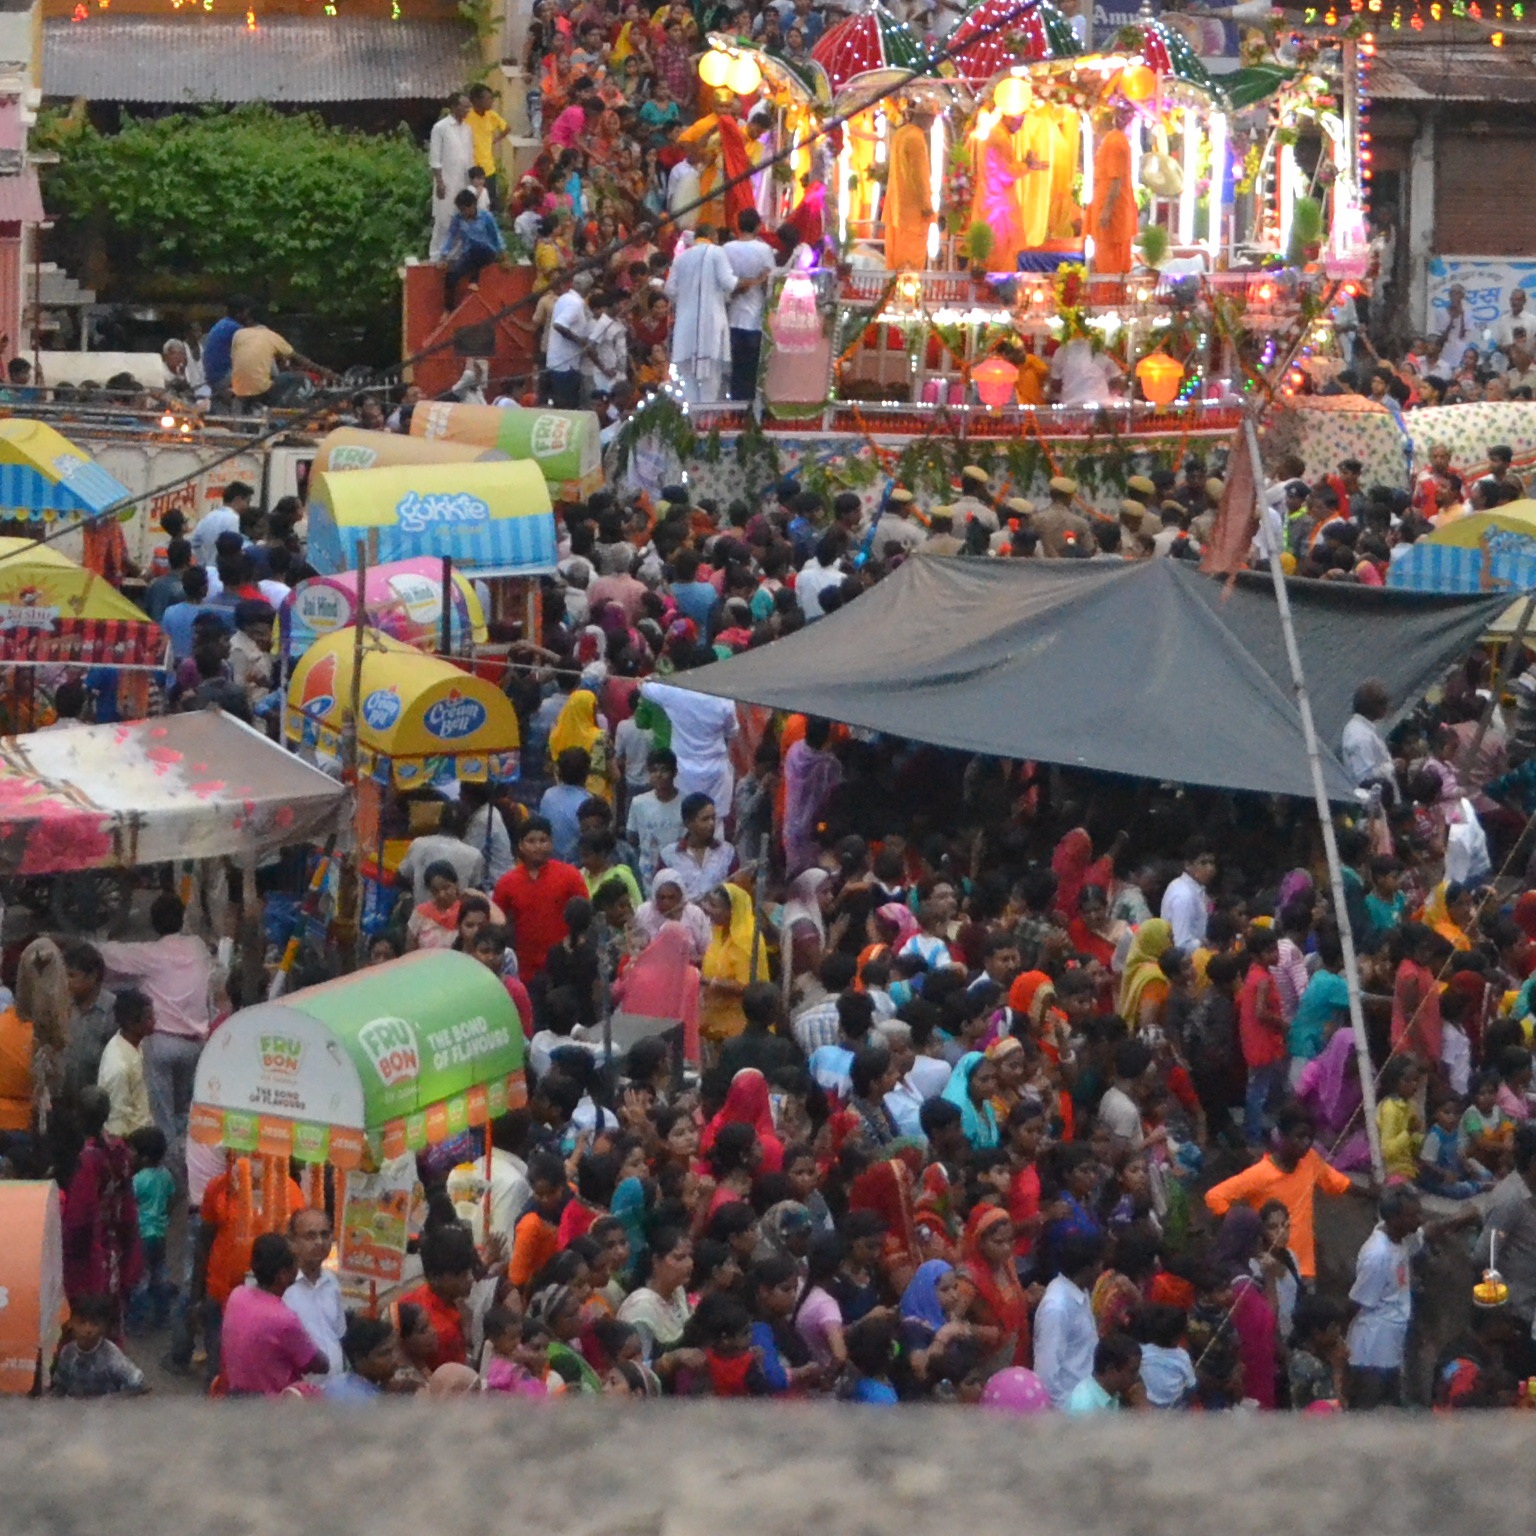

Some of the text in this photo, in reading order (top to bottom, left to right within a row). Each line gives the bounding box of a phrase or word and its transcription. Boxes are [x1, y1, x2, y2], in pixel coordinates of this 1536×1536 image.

[1094, 4, 1145, 24] Amu
[535, 416, 553, 452] FRU
[334, 448, 374, 464] FRU
[430, 703, 479, 724] Cream
[440, 716, 470, 738] Bell
[361, 1020, 411, 1057] FRU
[427, 1016, 488, 1051] THE BOND
[260, 1036, 302, 1056] FRU
[433, 1027, 511, 1072] OF FLAVOURS
[262, 1053, 299, 1070] BON
[379, 1049, 416, 1079] BON
[249, 1094, 306, 1110] OF FLAVOURS
[256, 1086, 300, 1100] THE BOND
